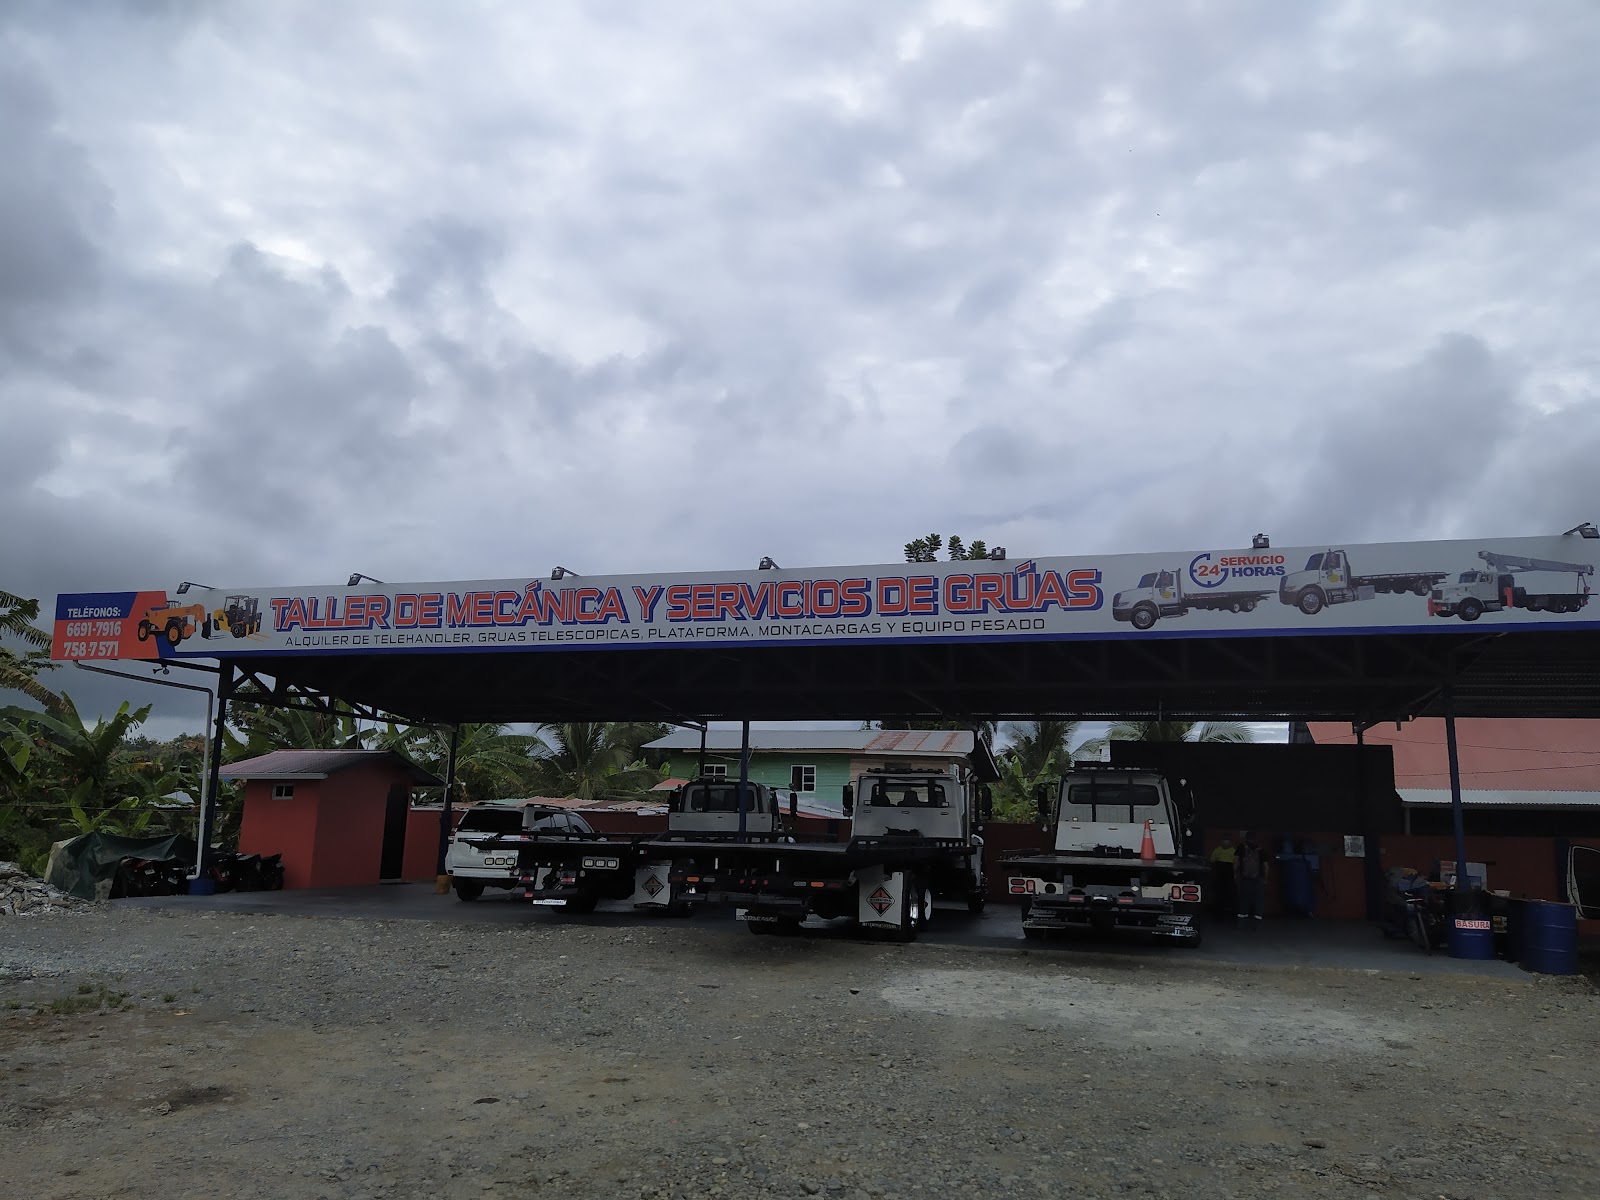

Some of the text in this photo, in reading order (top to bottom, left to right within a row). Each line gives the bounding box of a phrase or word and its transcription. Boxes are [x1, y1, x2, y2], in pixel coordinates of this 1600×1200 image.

[1220, 555, 1285, 567] SERVICIO
[1198, 565, 1286, 577] 24 HORAS
[270, 560, 1104, 632] TALLER DE MECÁNICA Y SERVICIOS DE GRÚAS
[67, 606, 122, 618] TELÉFONOS:
[66, 621, 122, 637] 6691-7916
[285, 618, 1046, 647] ALQUILER DE TELEHANDLER, GRUAS TELESCOPICAS, PLATAFORMA, MONTACARGAS Y EQUIPO PESADO
[1456, 920, 1490, 929] BASURA
